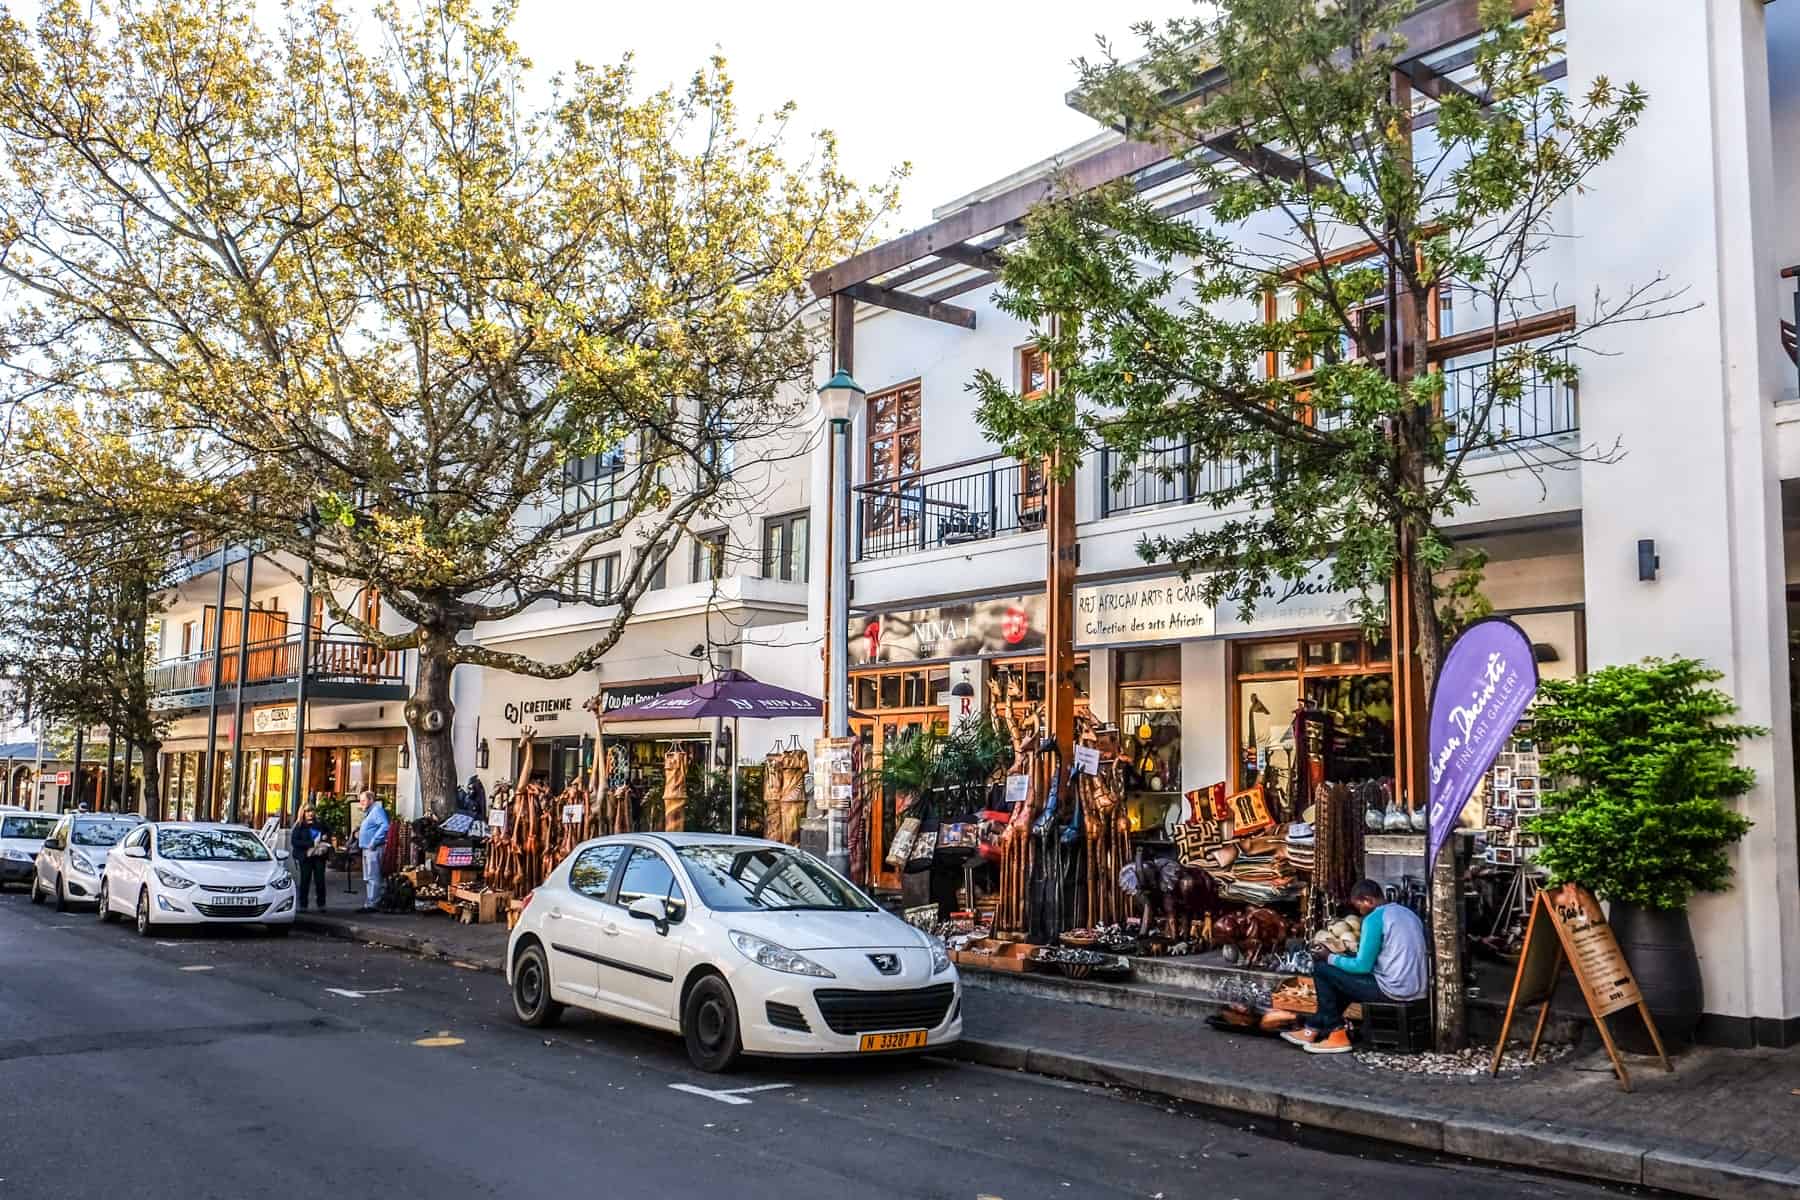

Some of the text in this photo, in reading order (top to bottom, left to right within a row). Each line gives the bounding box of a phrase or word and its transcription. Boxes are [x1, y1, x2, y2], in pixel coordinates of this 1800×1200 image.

[1079, 595, 1096, 613] RAJ
[1099, 591, 1138, 611] AFRICAN
[1141, 589, 1163, 607] ARTS
[1177, 584, 1204, 602] CRAF
[913, 619, 957, 642] NINA
[1086, 620, 1127, 634] Collection
[1130, 617, 1145, 632] des
[1148, 619, 1166, 630] arts
[523, 698, 572, 713] CRETIENNE
[1455, 670, 1519, 771] FINE ART GALLERY
